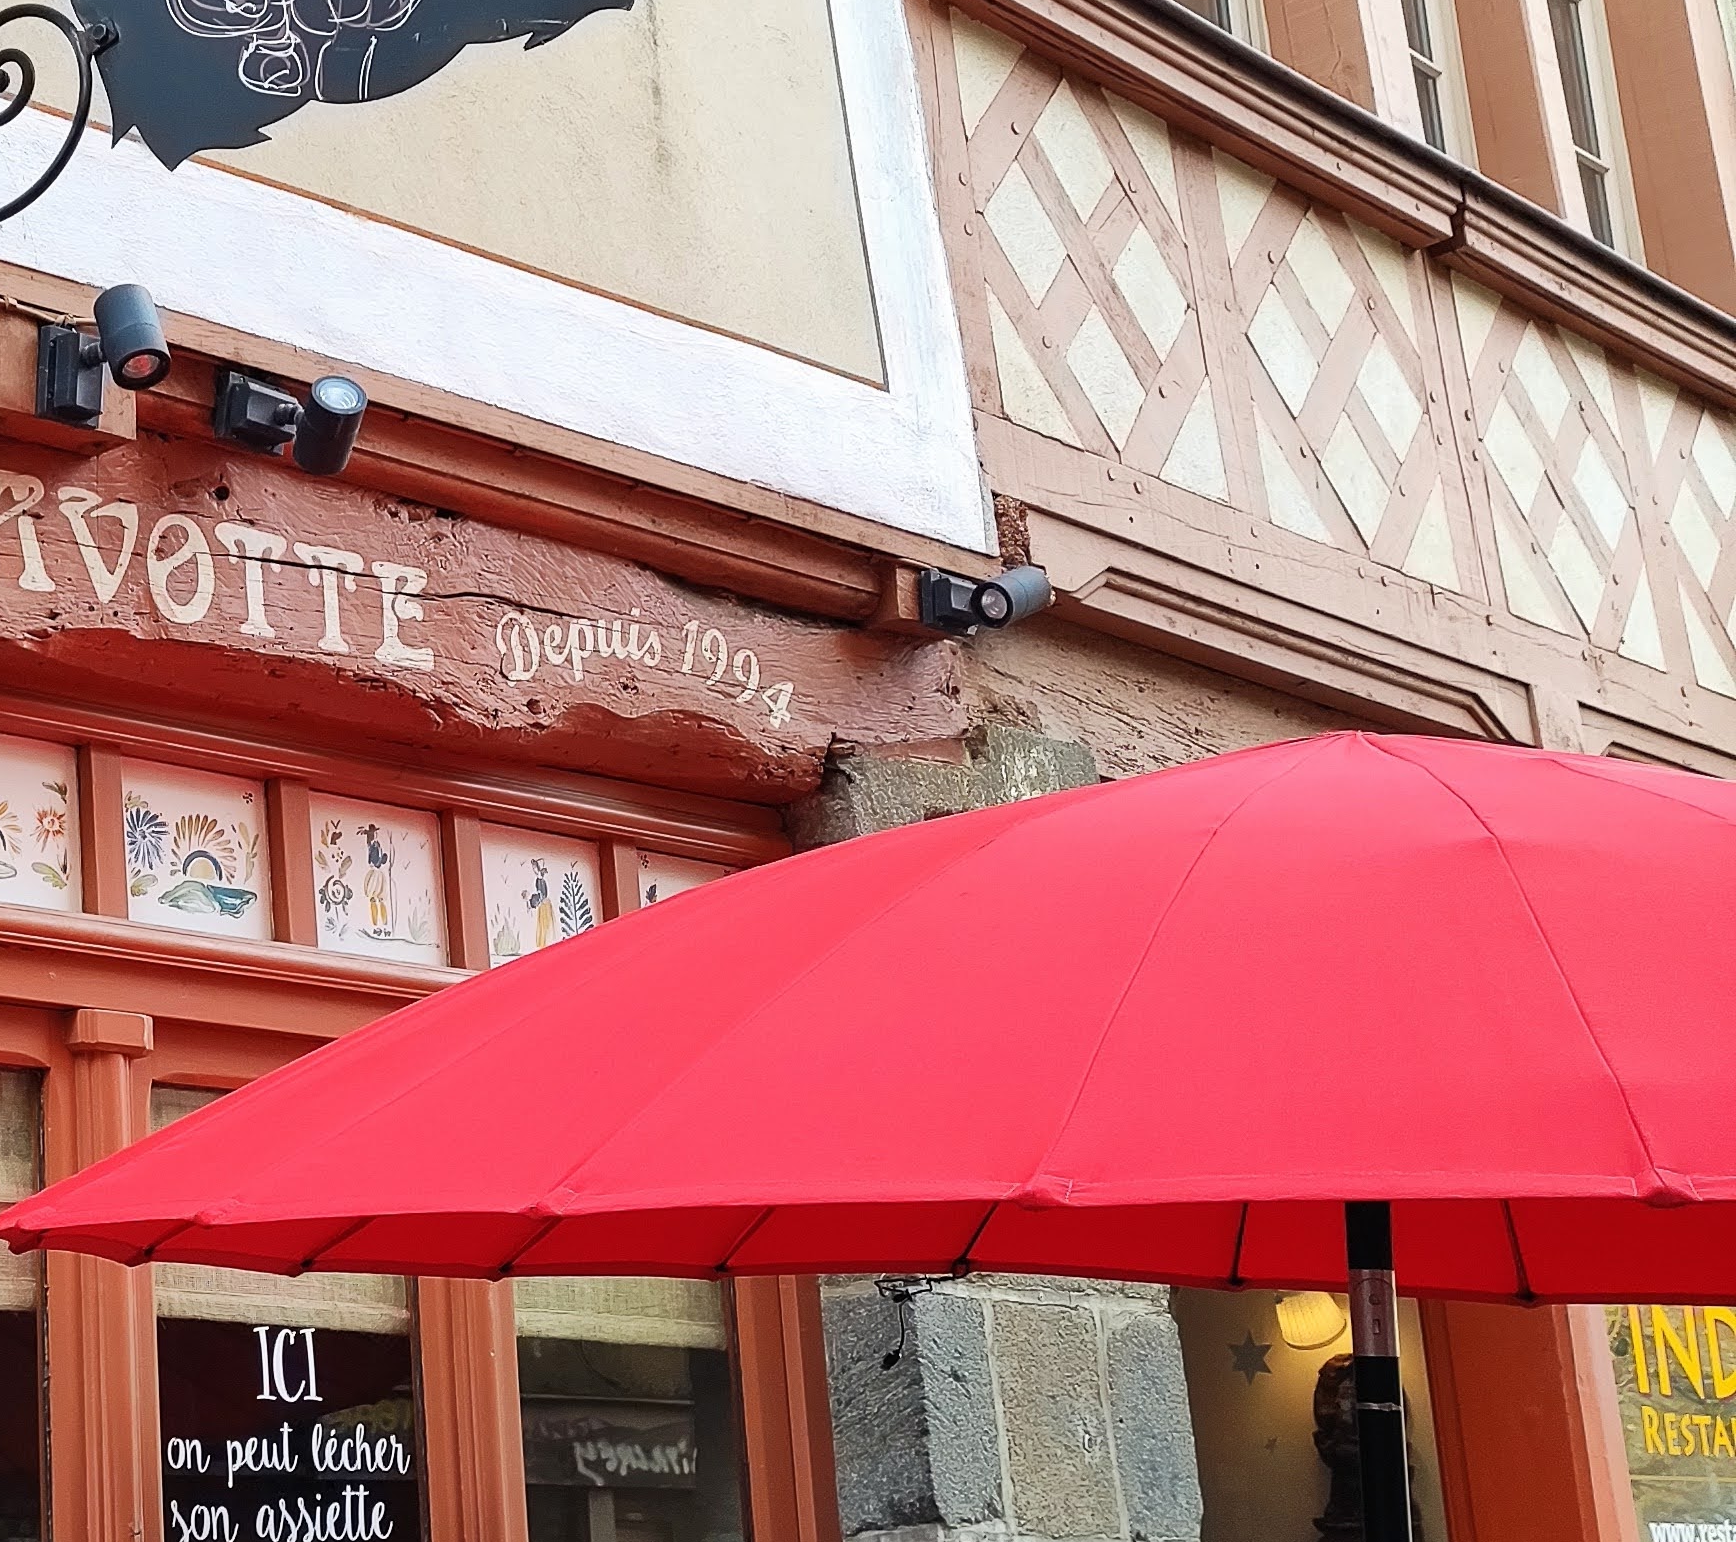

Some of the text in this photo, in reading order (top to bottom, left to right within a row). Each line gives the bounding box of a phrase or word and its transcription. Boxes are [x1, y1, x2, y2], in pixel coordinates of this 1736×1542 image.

[495, 608, 796, 731] Depuis 1994
[253, 1326, 323, 1402] ICI
[167, 1421, 410, 1488] on peut lécher
[1641, 1406, 1736, 1458] RESTA
